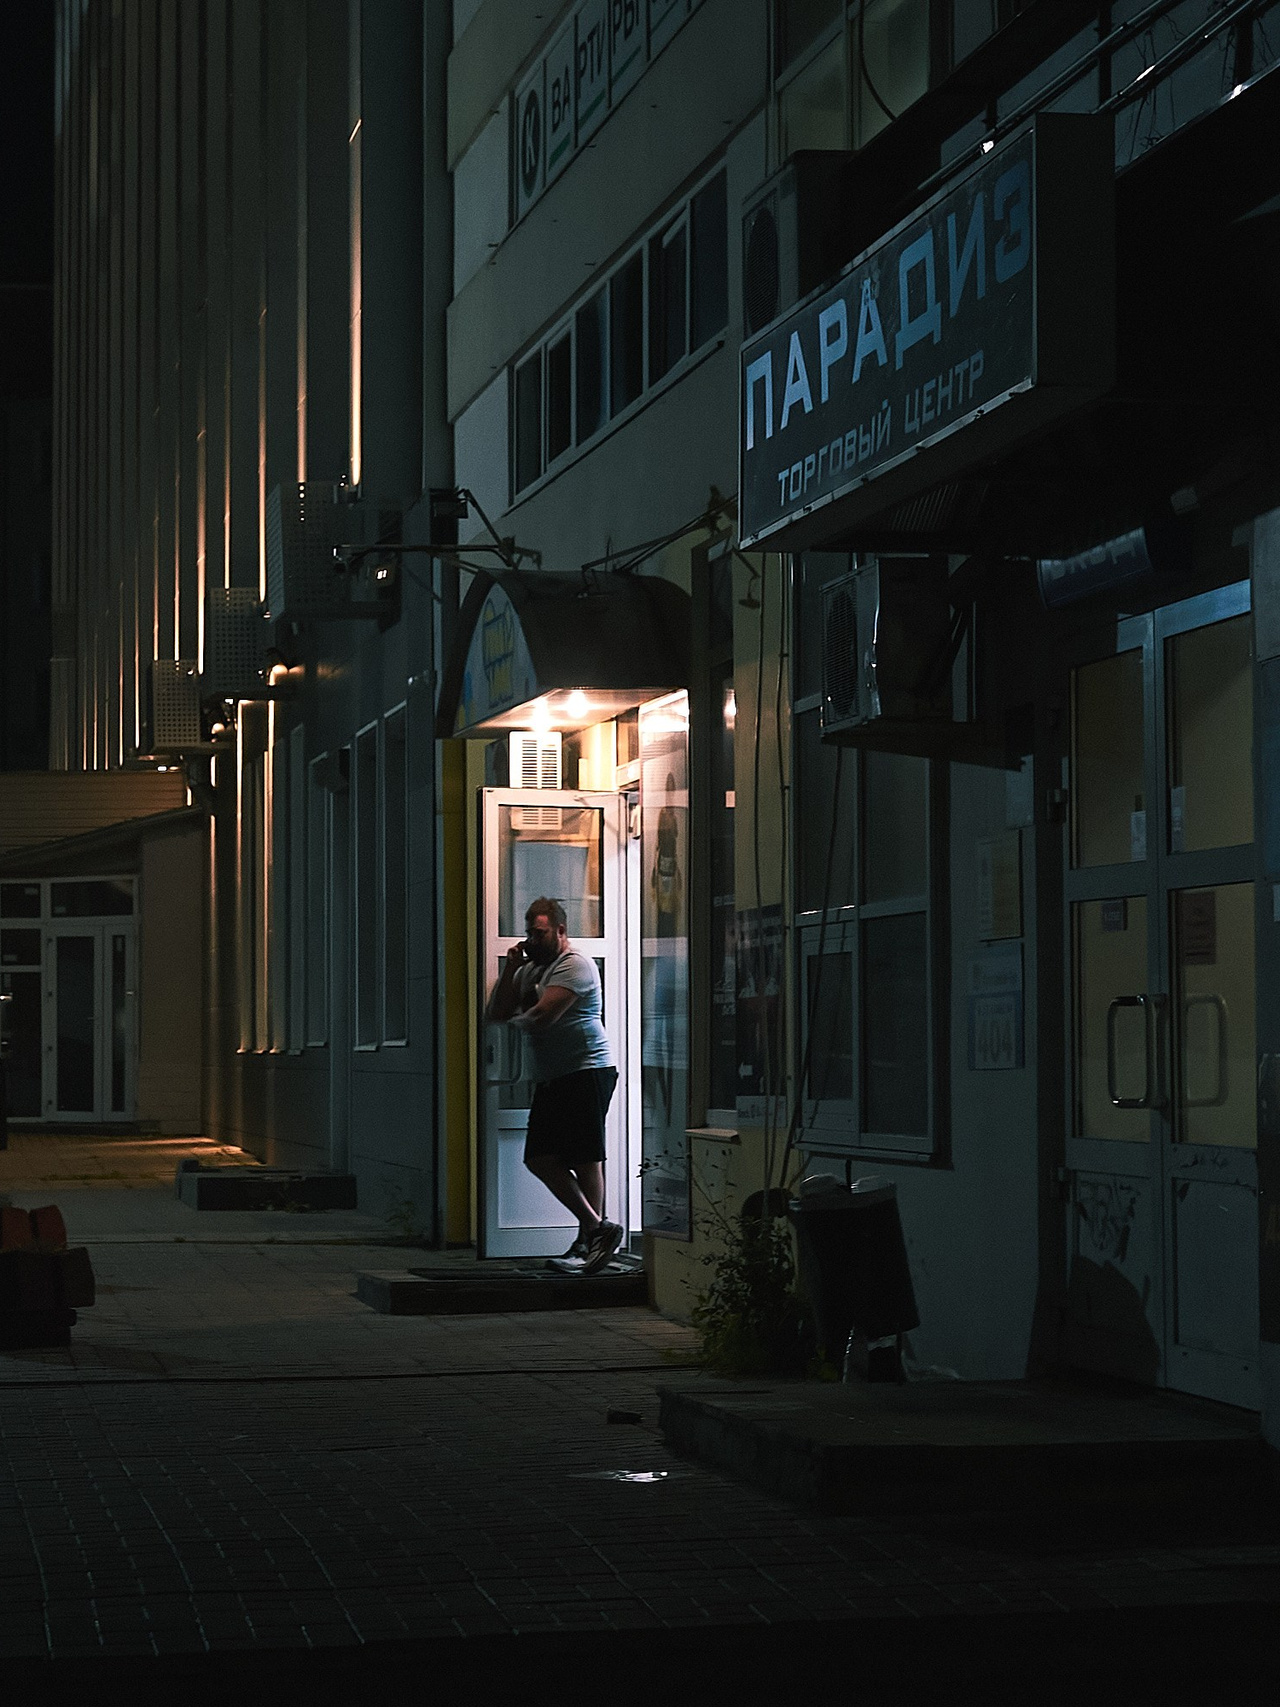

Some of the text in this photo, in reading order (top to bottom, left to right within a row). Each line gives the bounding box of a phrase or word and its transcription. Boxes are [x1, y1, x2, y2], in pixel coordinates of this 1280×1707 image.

[746, 160, 1029, 451] ПАРАДИЗ
[778, 349, 984, 506] ТОРГОВЫЙ ЦЕНТР
